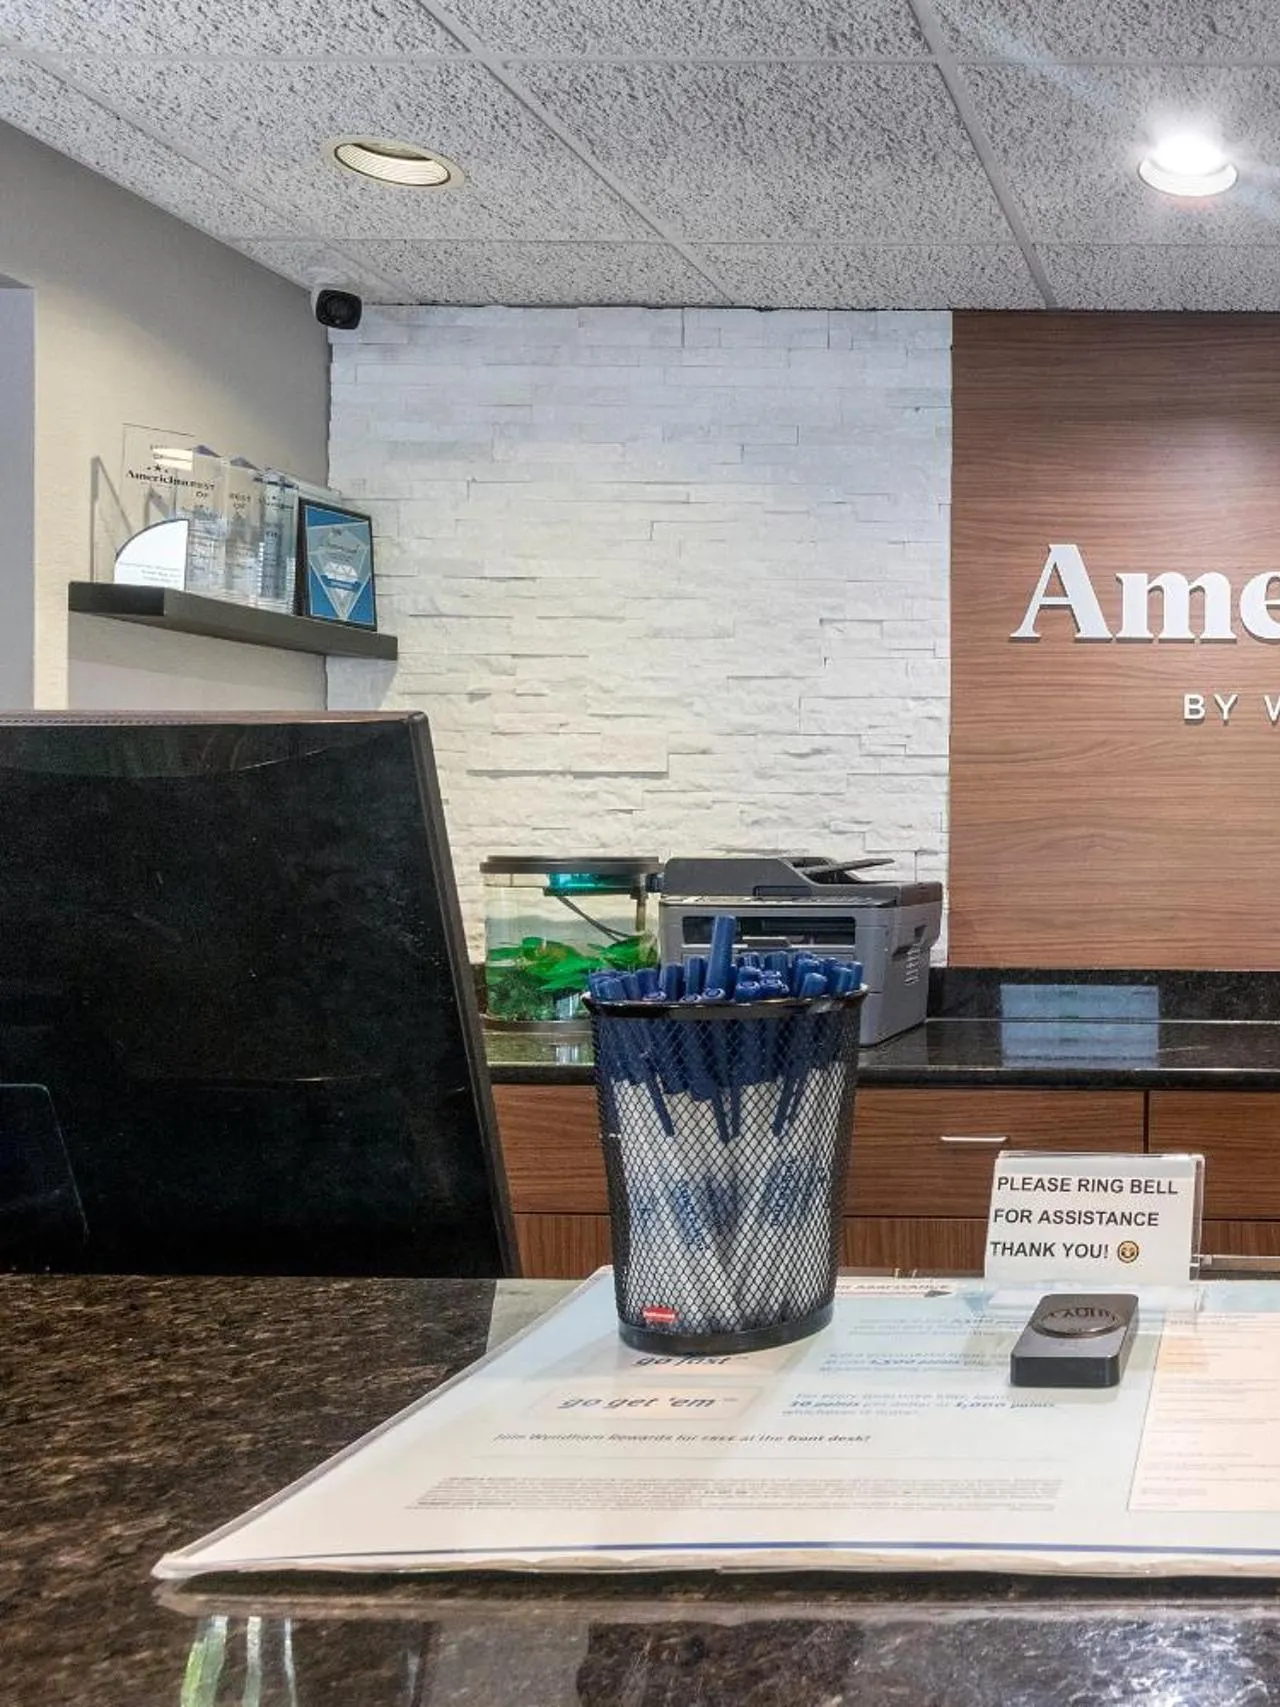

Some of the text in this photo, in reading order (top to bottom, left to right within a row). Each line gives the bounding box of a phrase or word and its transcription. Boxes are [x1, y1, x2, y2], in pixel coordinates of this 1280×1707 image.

[1182, 693, 1238, 722] BY
[997, 1176, 1179, 1195] PLEASE RING BELL
[993, 1208, 1160, 1227] FOR ASSISTANCE
[990, 1241, 1109, 1259] THANK YOU!
[632, 1356, 673, 1367] go
[557, 1397, 601, 1409] go
[602, 1397, 660, 1409] get
